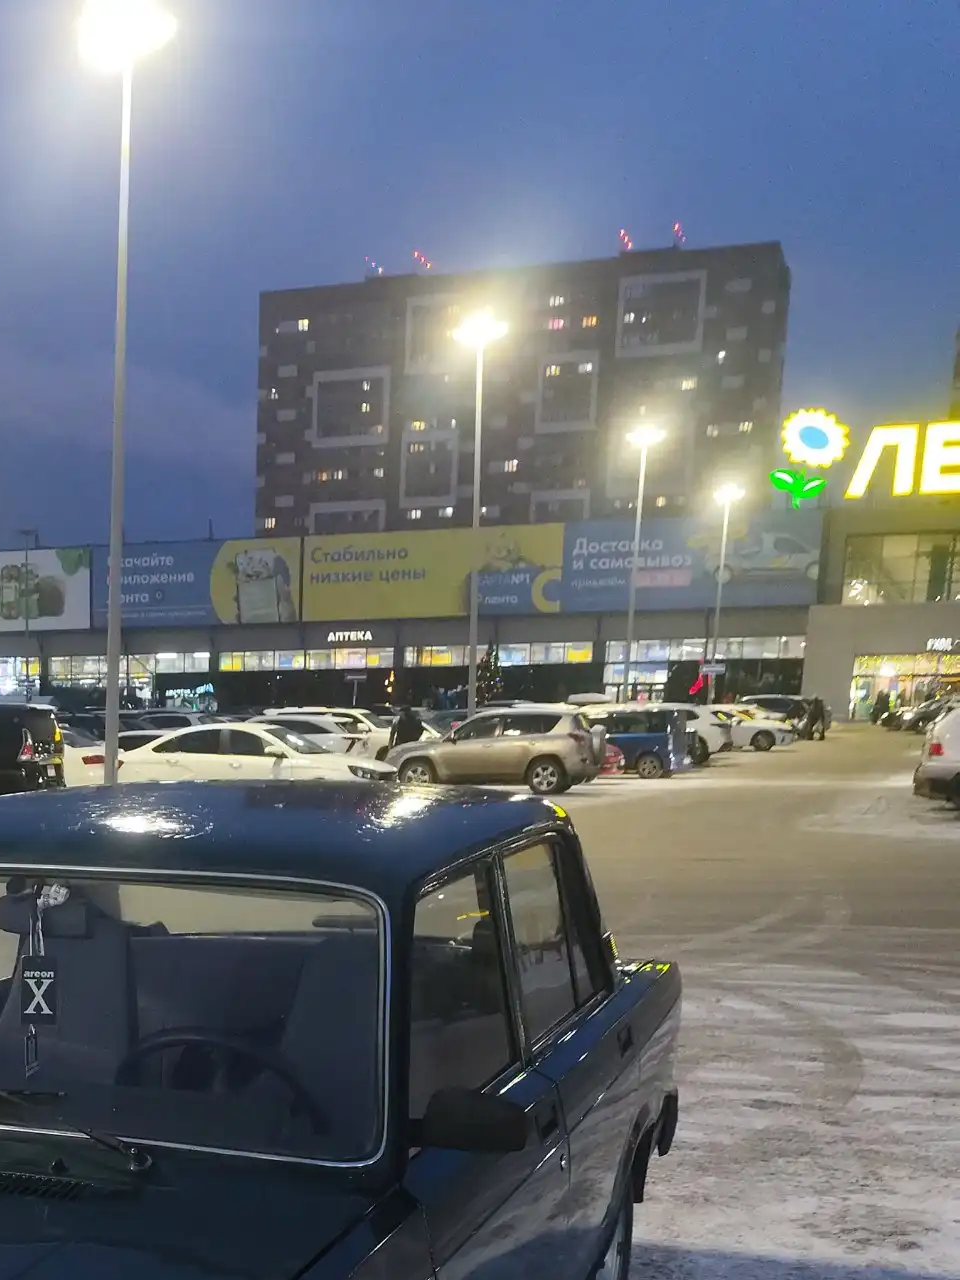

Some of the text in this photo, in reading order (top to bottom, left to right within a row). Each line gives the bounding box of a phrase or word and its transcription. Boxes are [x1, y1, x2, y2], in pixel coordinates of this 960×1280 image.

[844, 421, 960, 499] ЛЕ
[310, 544, 408, 564] Стабильно
[309, 567, 426, 584] низкие цены
[327, 630, 373, 643] АПТЕКА
[24, 970, 55, 978] areon
[23, 978, 54, 1015] X
